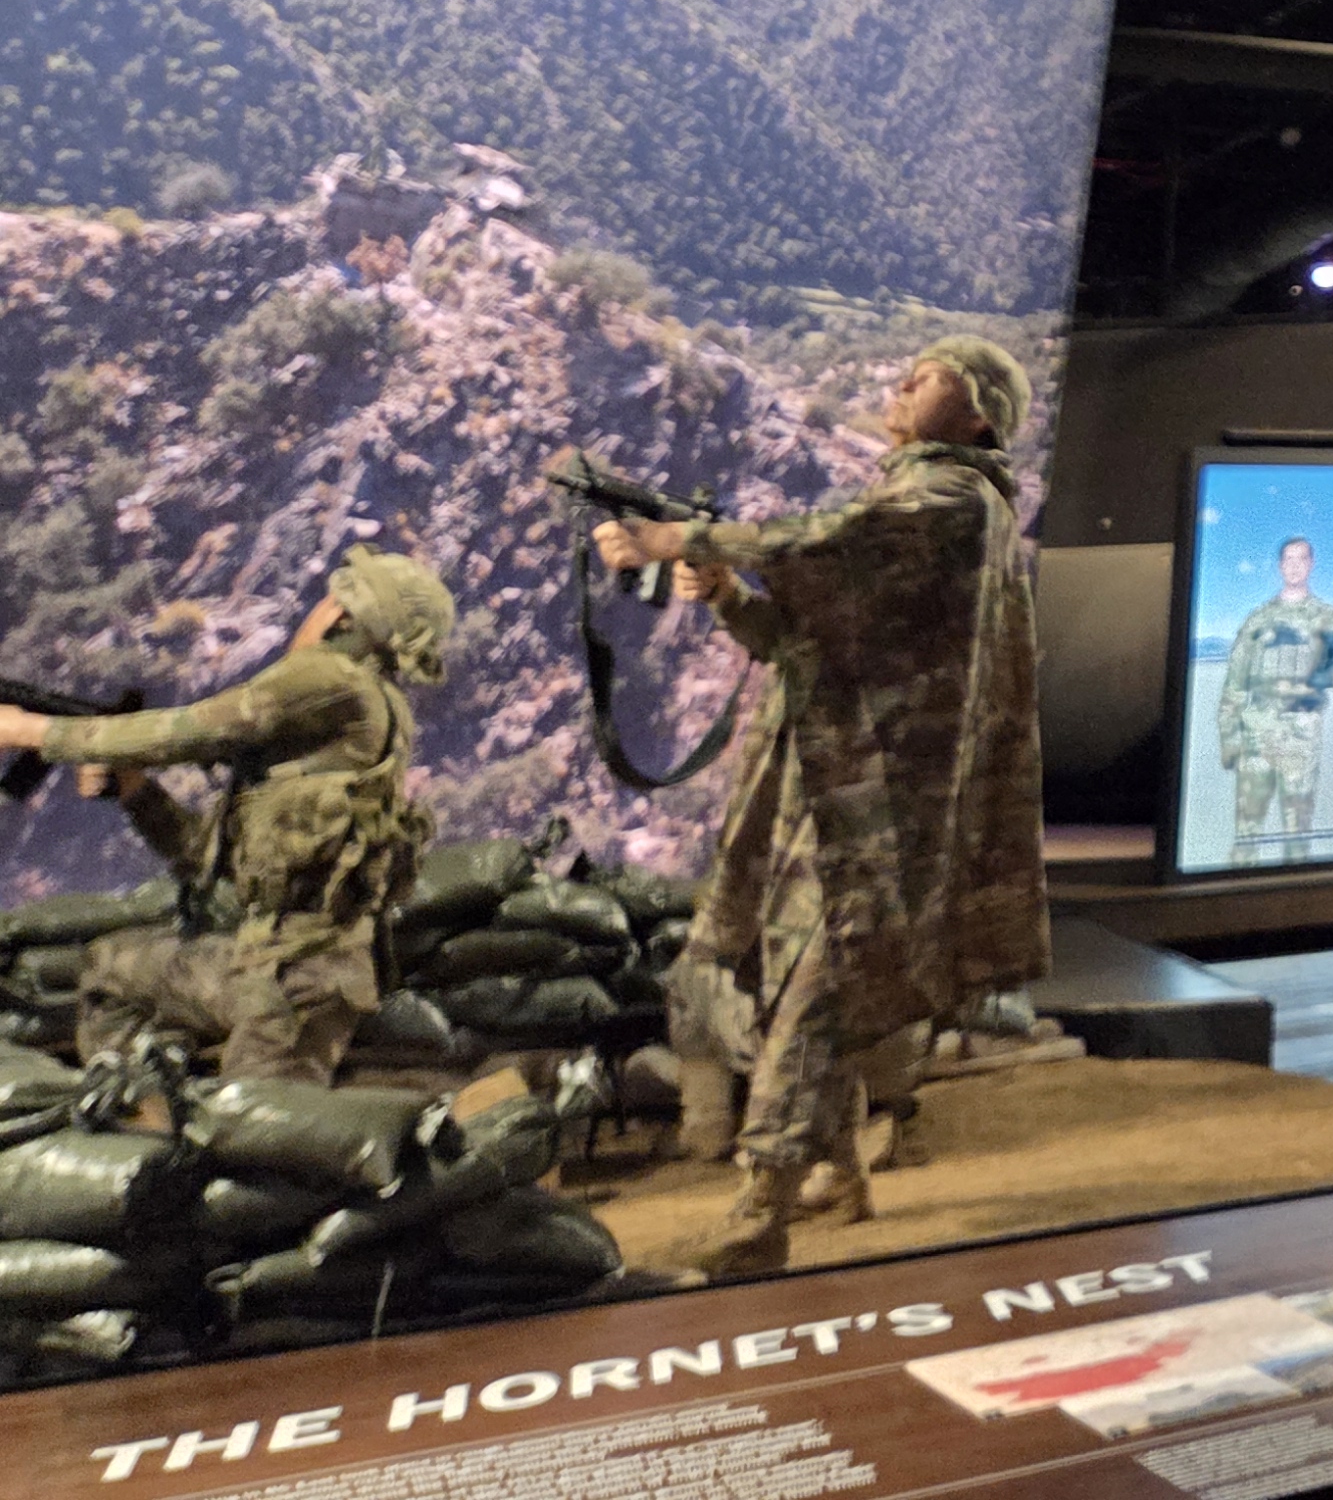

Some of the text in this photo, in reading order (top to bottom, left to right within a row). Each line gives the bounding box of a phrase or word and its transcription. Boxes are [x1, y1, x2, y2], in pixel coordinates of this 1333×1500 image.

[90, 1405, 344, 1483] THE
[386, 1302, 954, 1432] HORNET'S
[981, 1250, 1213, 1321] NEST
